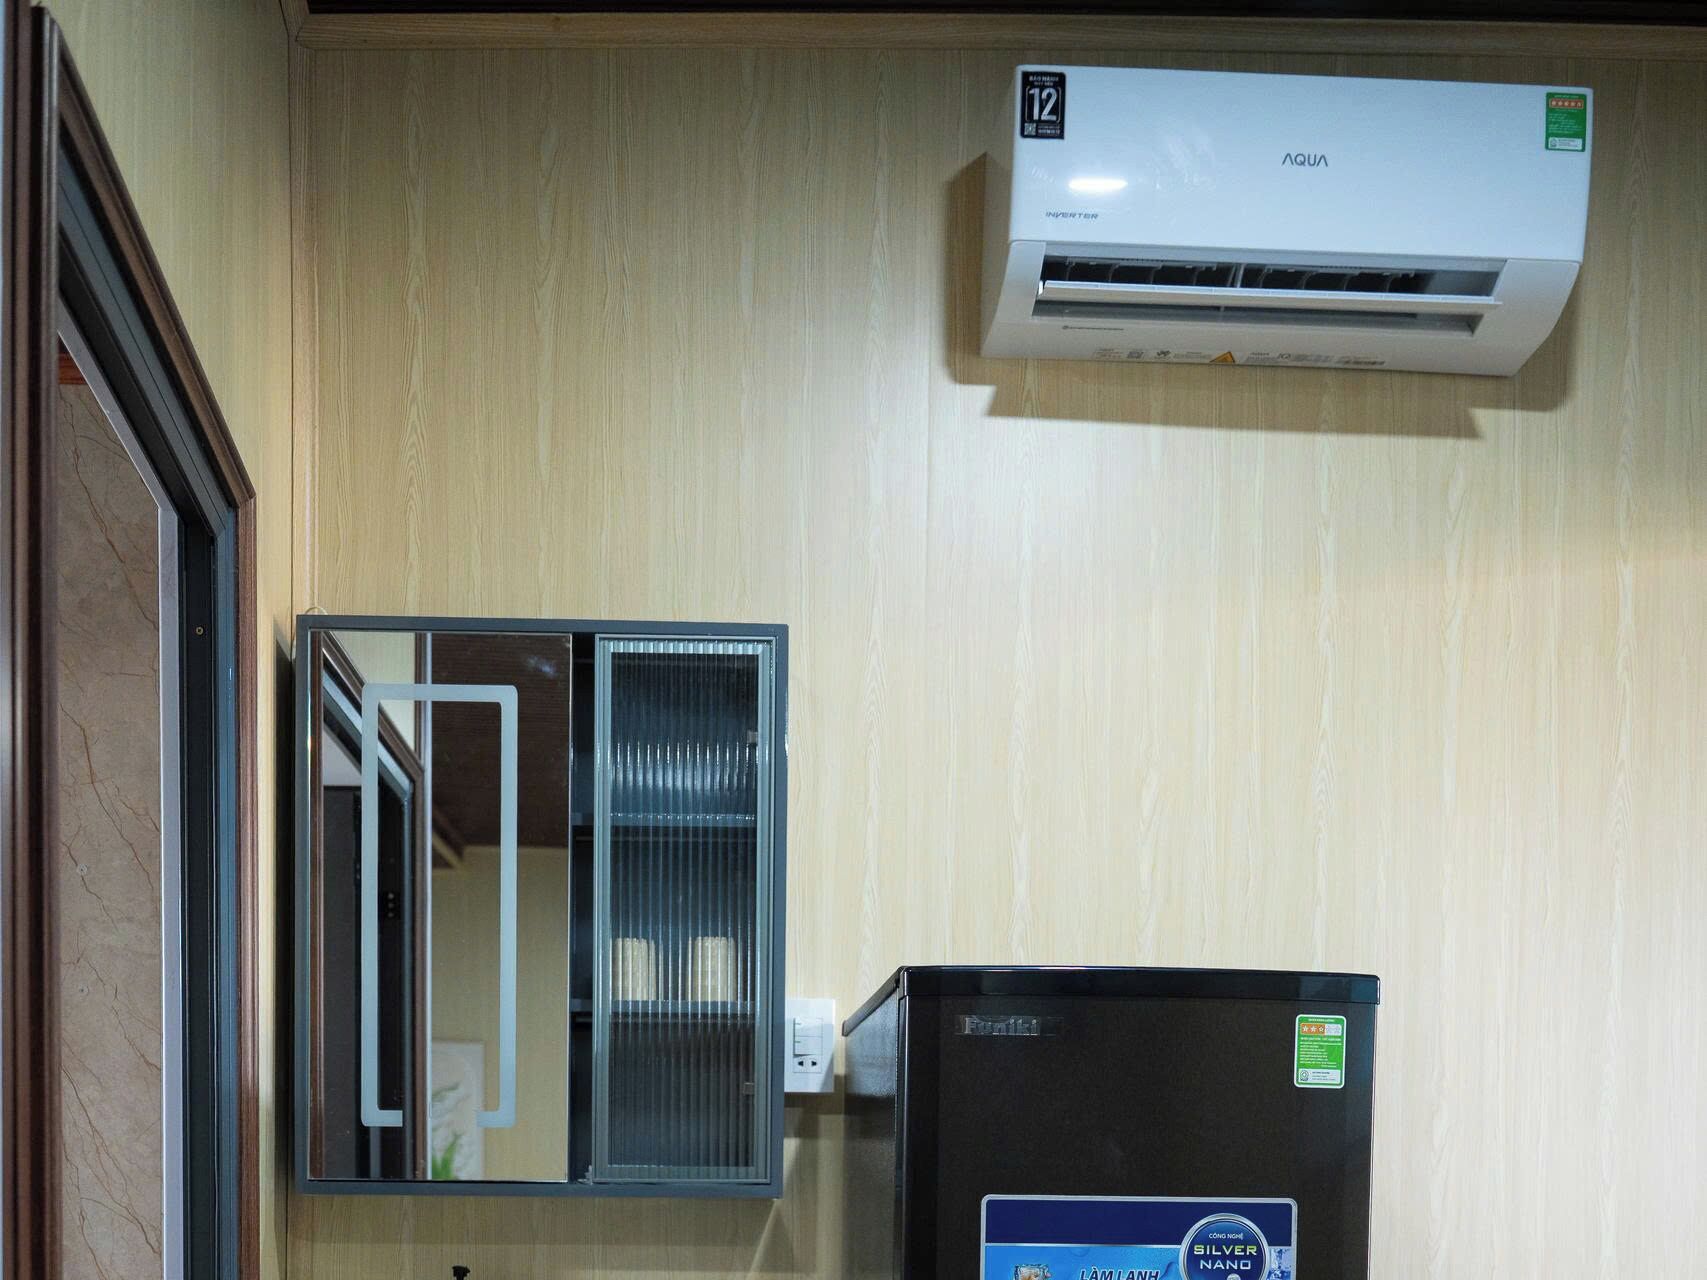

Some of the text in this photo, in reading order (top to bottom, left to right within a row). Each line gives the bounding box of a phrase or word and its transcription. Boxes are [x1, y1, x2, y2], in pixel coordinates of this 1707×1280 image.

[1028, 87, 1058, 121] 12
[1281, 152, 1329, 168] AQUA
[1045, 211, 1099, 220] INVERTER
[963, 1017, 1039, 1035] Funiki
[1193, 1244, 1257, 1256] SILVER
[1199, 1259, 1252, 1270] NANO
